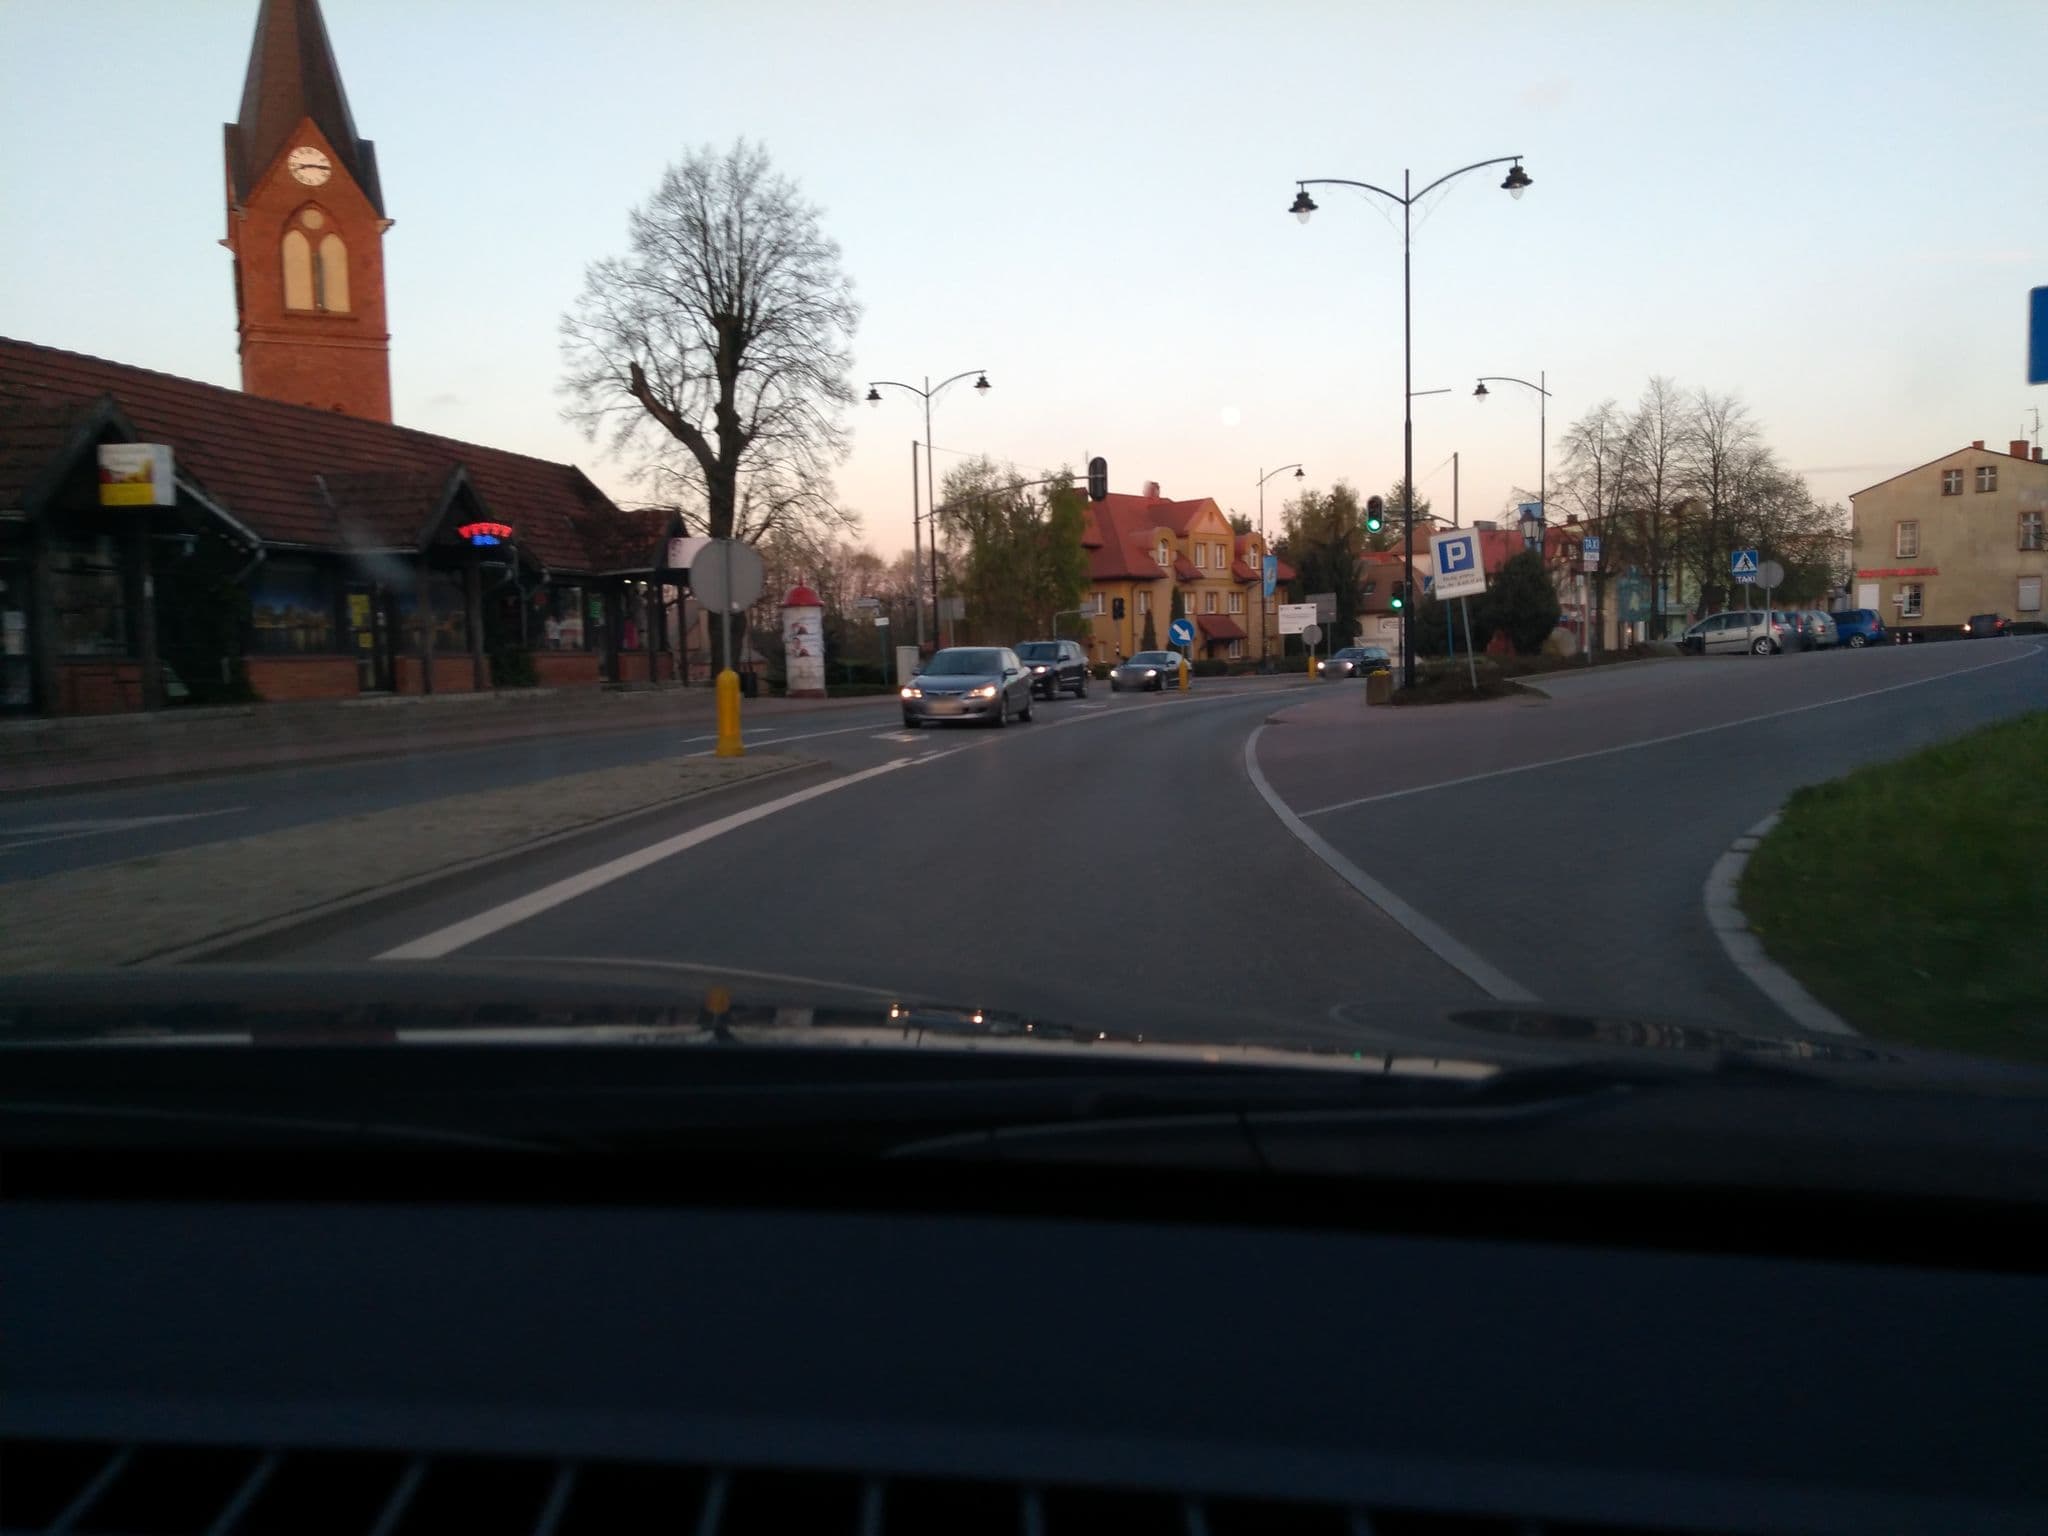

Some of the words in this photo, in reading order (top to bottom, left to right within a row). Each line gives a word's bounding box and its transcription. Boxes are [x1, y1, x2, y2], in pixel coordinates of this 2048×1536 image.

[1584, 538, 1600, 550] TAXI
[1446, 541, 1466, 569] P
[1736, 576, 1756, 585] TAXI
